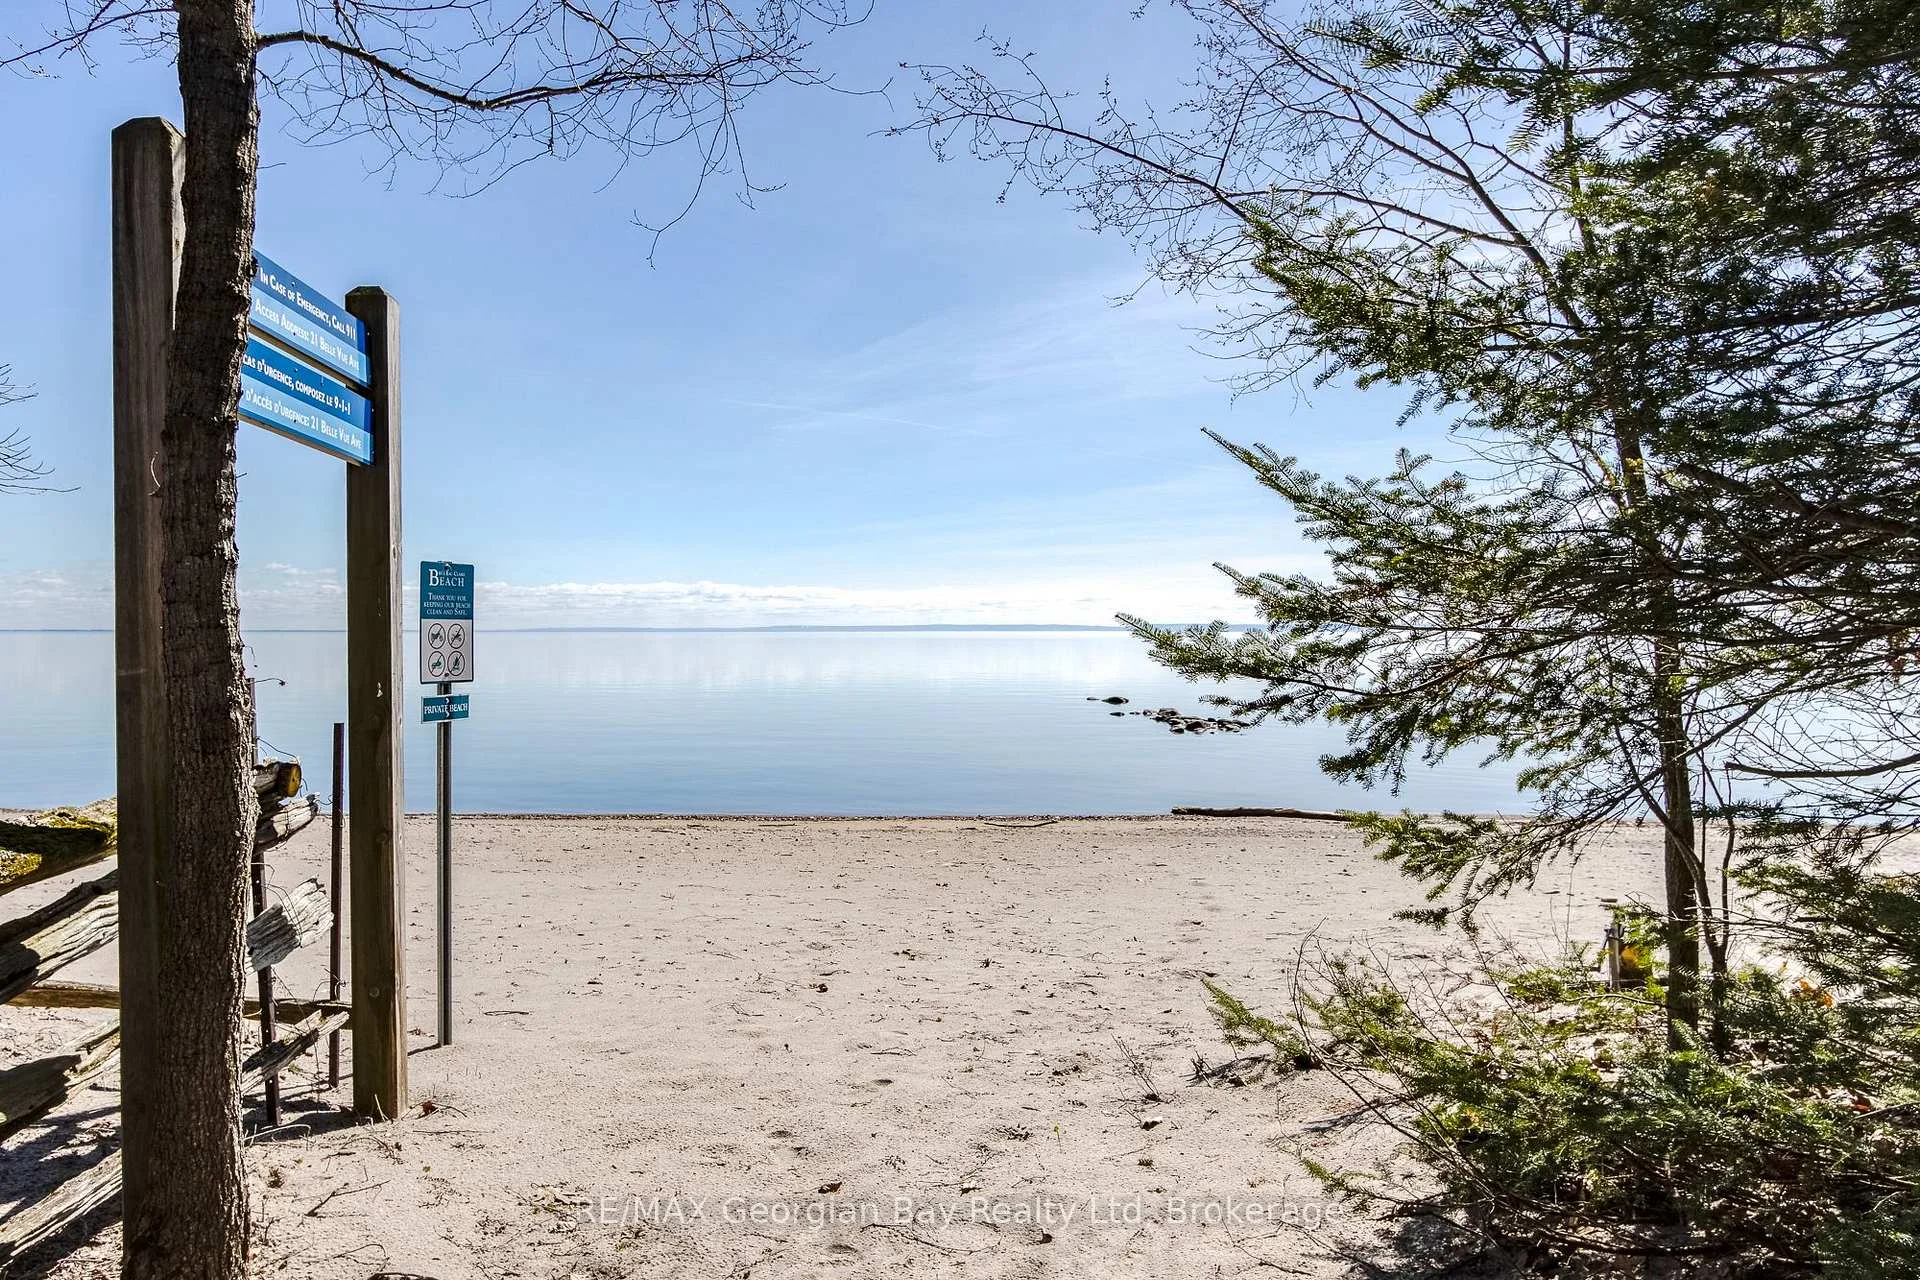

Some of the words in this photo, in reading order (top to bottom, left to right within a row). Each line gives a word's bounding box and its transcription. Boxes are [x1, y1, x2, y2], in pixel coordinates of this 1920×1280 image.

[270, 275, 287, 297] CASE
[297, 291, 331, 328] EMERGENCY,
[332, 315, 345, 334] CALL
[346, 324, 356, 341] 911
[310, 331, 318, 346] 21
[295, 380, 326, 404] COMPOSEZ
[326, 395, 333, 407] LE
[334, 396, 351, 415] 9-1-1
[311, 415, 318, 431] 21
[428, 568, 465, 587] BEACH
[428, 592, 446, 601] THANK
[424, 704, 448, 714] PRIVATE
[449, 703, 468, 713] BEACH
